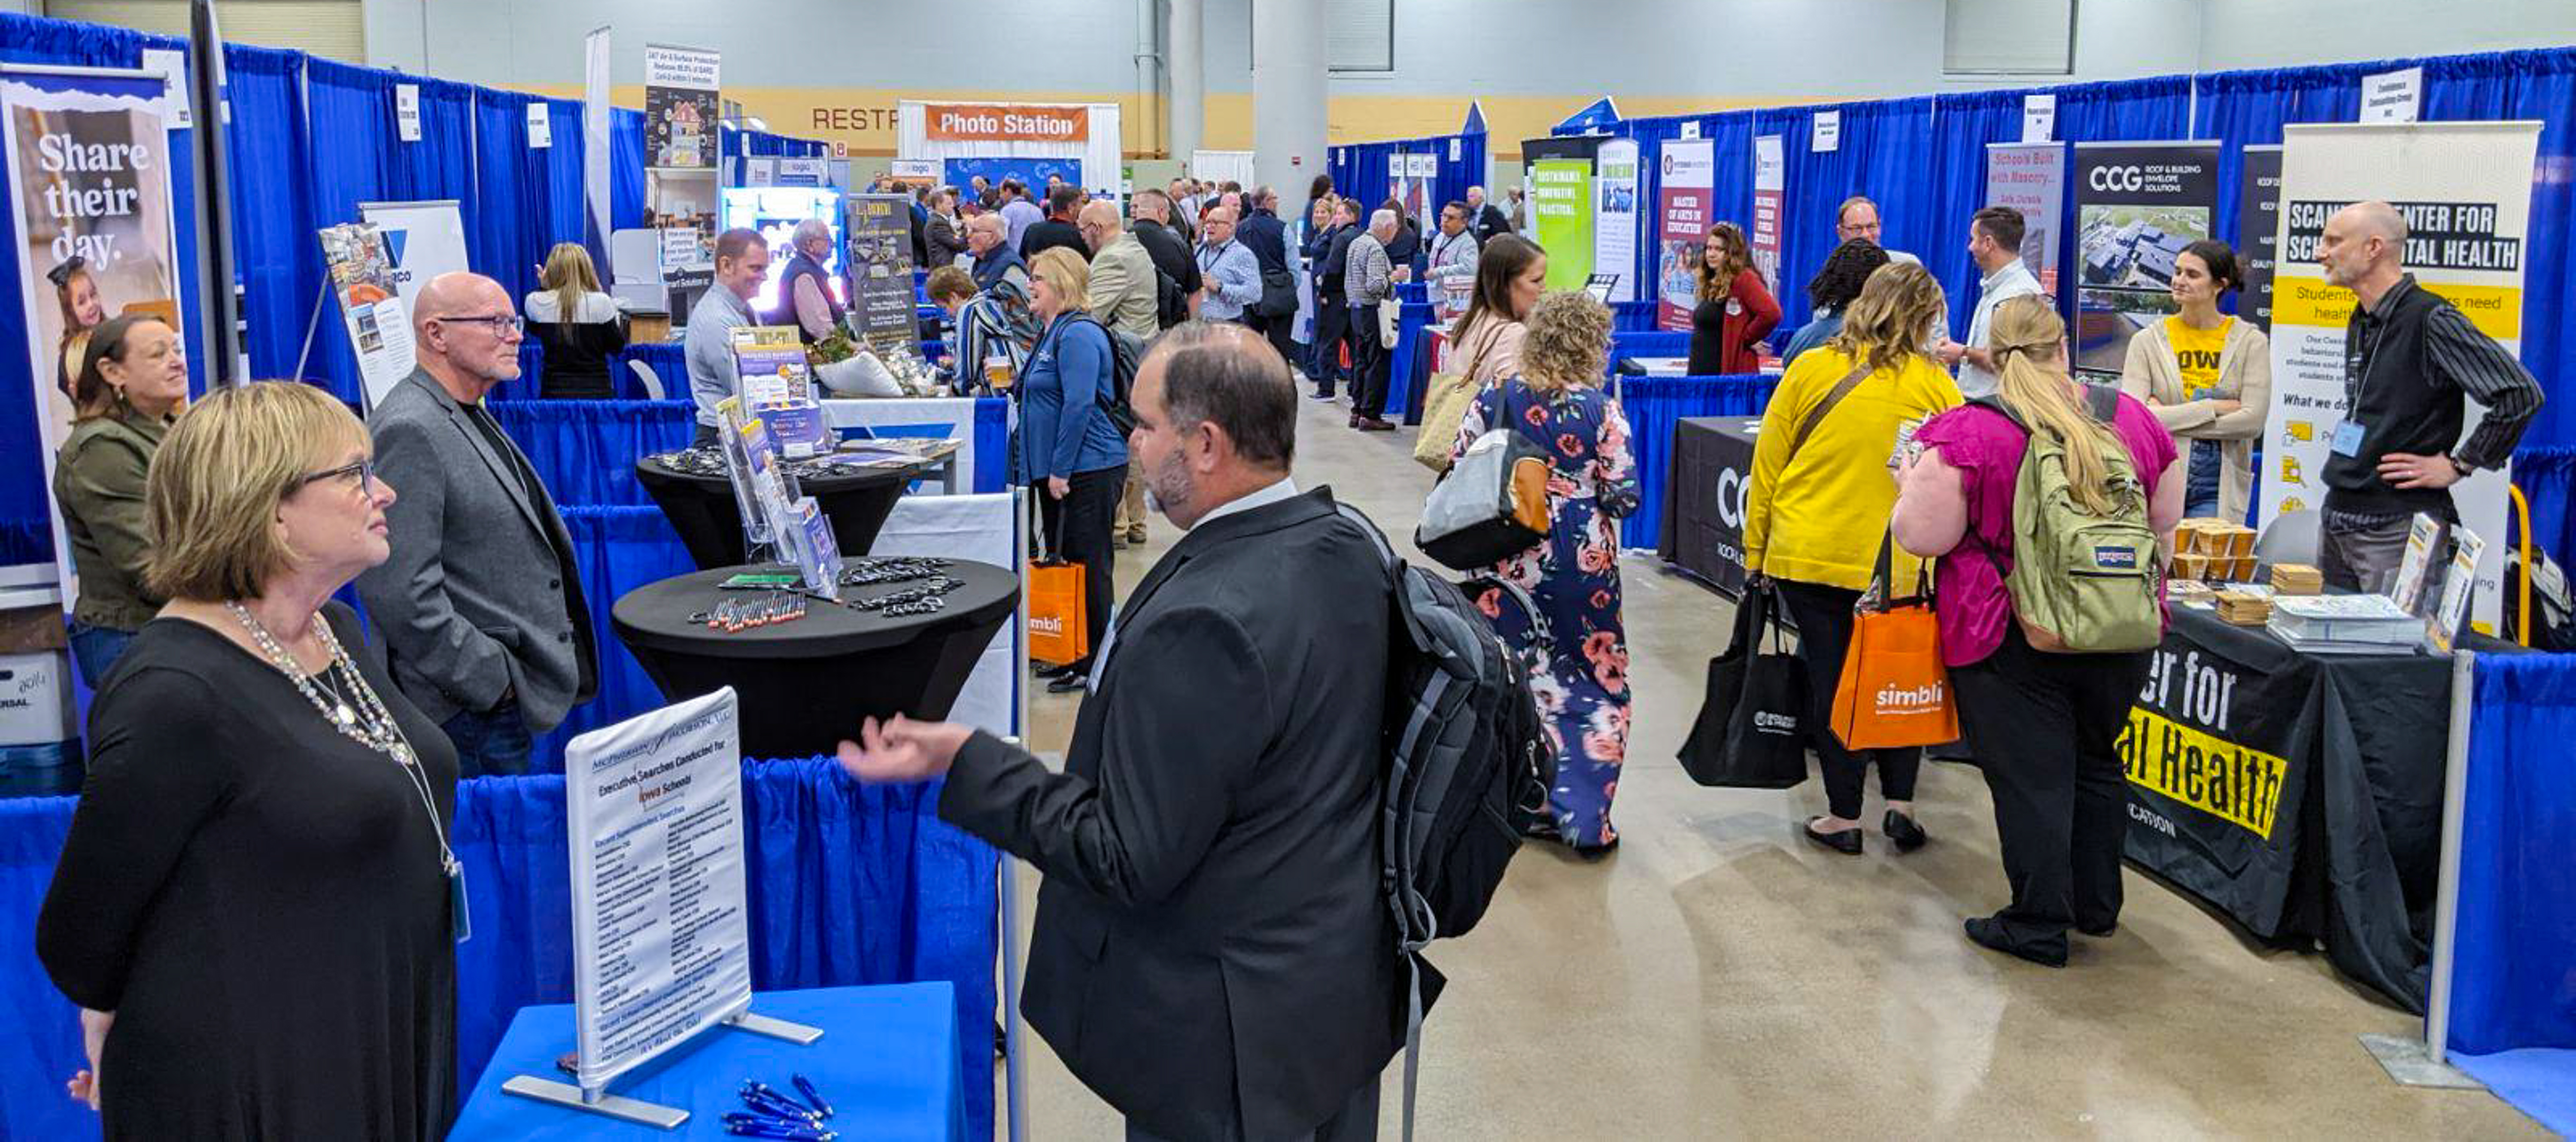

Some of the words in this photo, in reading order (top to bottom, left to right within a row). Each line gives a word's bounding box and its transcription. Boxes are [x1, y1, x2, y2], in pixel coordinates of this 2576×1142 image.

[941, 112, 998, 134] Photo
[1004, 114, 1073, 135] Station
[39, 134, 151, 172] Share
[1995, 152, 2030, 166] Schools
[2034, 151, 2054, 165] Built
[2089, 166, 2143, 191] CCG
[2172, 165, 2202, 173] BUILDING
[2145, 175, 2178, 183] ENVELOPE
[2145, 184, 2181, 192] SOLUTIONS
[45, 178, 138, 218] their
[2399, 204, 2449, 232] NTER
[2454, 206, 2494, 234] FOR
[52, 228, 122, 271] day.
[2289, 235, 2325, 260] SCH
[2444, 239, 2516, 268] HEALTH
[2297, 286, 2356, 303] Students
[2465, 296, 2502, 310] need
[2283, 393, 2312, 407] What
[2315, 398, 2331, 409] we
[1876, 679, 1943, 706] simbli
[2182, 651, 2237, 731] for
[598, 774, 638, 797] Executive
[638, 761, 675, 783] Searches
[675, 744, 714, 768] Conducted
[2160, 725, 2279, 829] Health
[638, 788, 661, 803] Iowa
[662, 775, 692, 796] Schools
[2128, 803, 2176, 839] CATION
